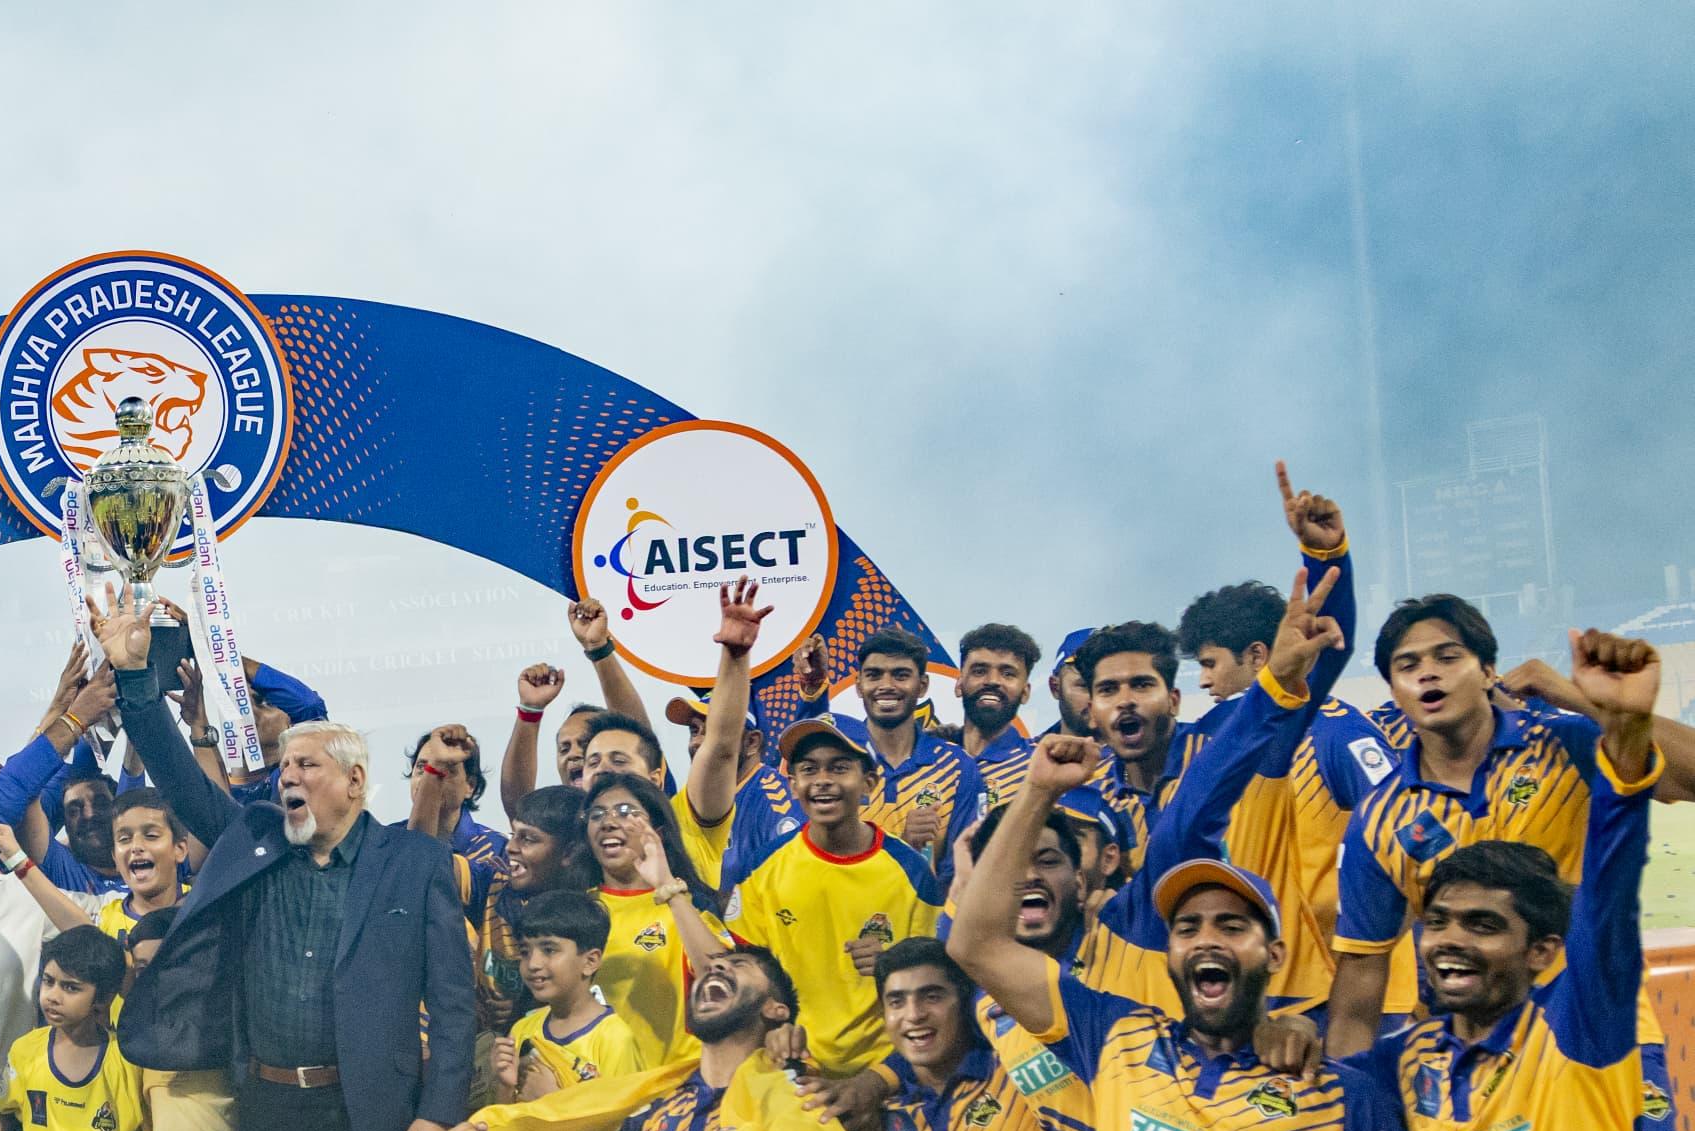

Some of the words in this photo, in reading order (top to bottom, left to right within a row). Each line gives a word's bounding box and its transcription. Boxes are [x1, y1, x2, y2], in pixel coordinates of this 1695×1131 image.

[10, 334, 58, 473] MADHYA
[44, 279, 202, 340] PRADESH
[197, 308, 264, 436] LEAGUE
[66, 490, 80, 531] adani
[197, 528, 215, 567] adani
[644, 530, 806, 575] AISECT
[203, 576, 222, 616] adani
[644, 582, 691, 592] Education.
[762, 575, 810, 585] Enterprise.
[210, 624, 229, 664] adani
[223, 720, 241, 760] adani
[240, 723, 262, 763] adani
